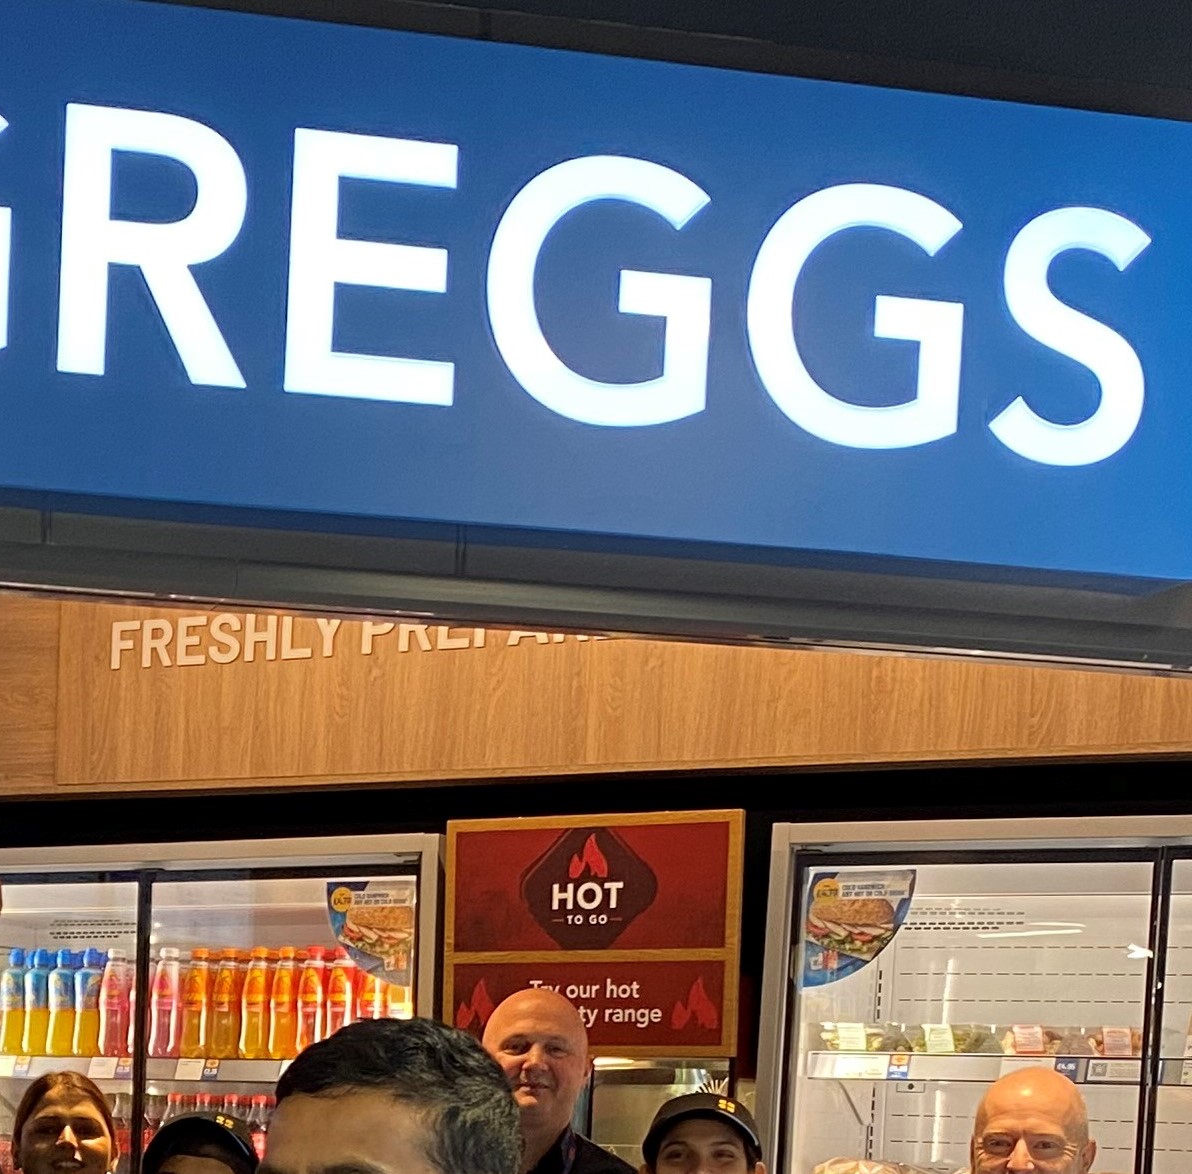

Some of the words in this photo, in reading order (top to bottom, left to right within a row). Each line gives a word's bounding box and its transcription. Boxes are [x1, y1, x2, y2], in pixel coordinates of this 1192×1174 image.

[110, 613, 341, 671] FRESHLY
[551, 881, 624, 911] HOT
[566, 914, 583, 925] TO
[589, 914, 608, 925] GO
[565, 984, 600, 999] our
[606, 978, 640, 999] hot
[604, 1007, 663, 1029] range
